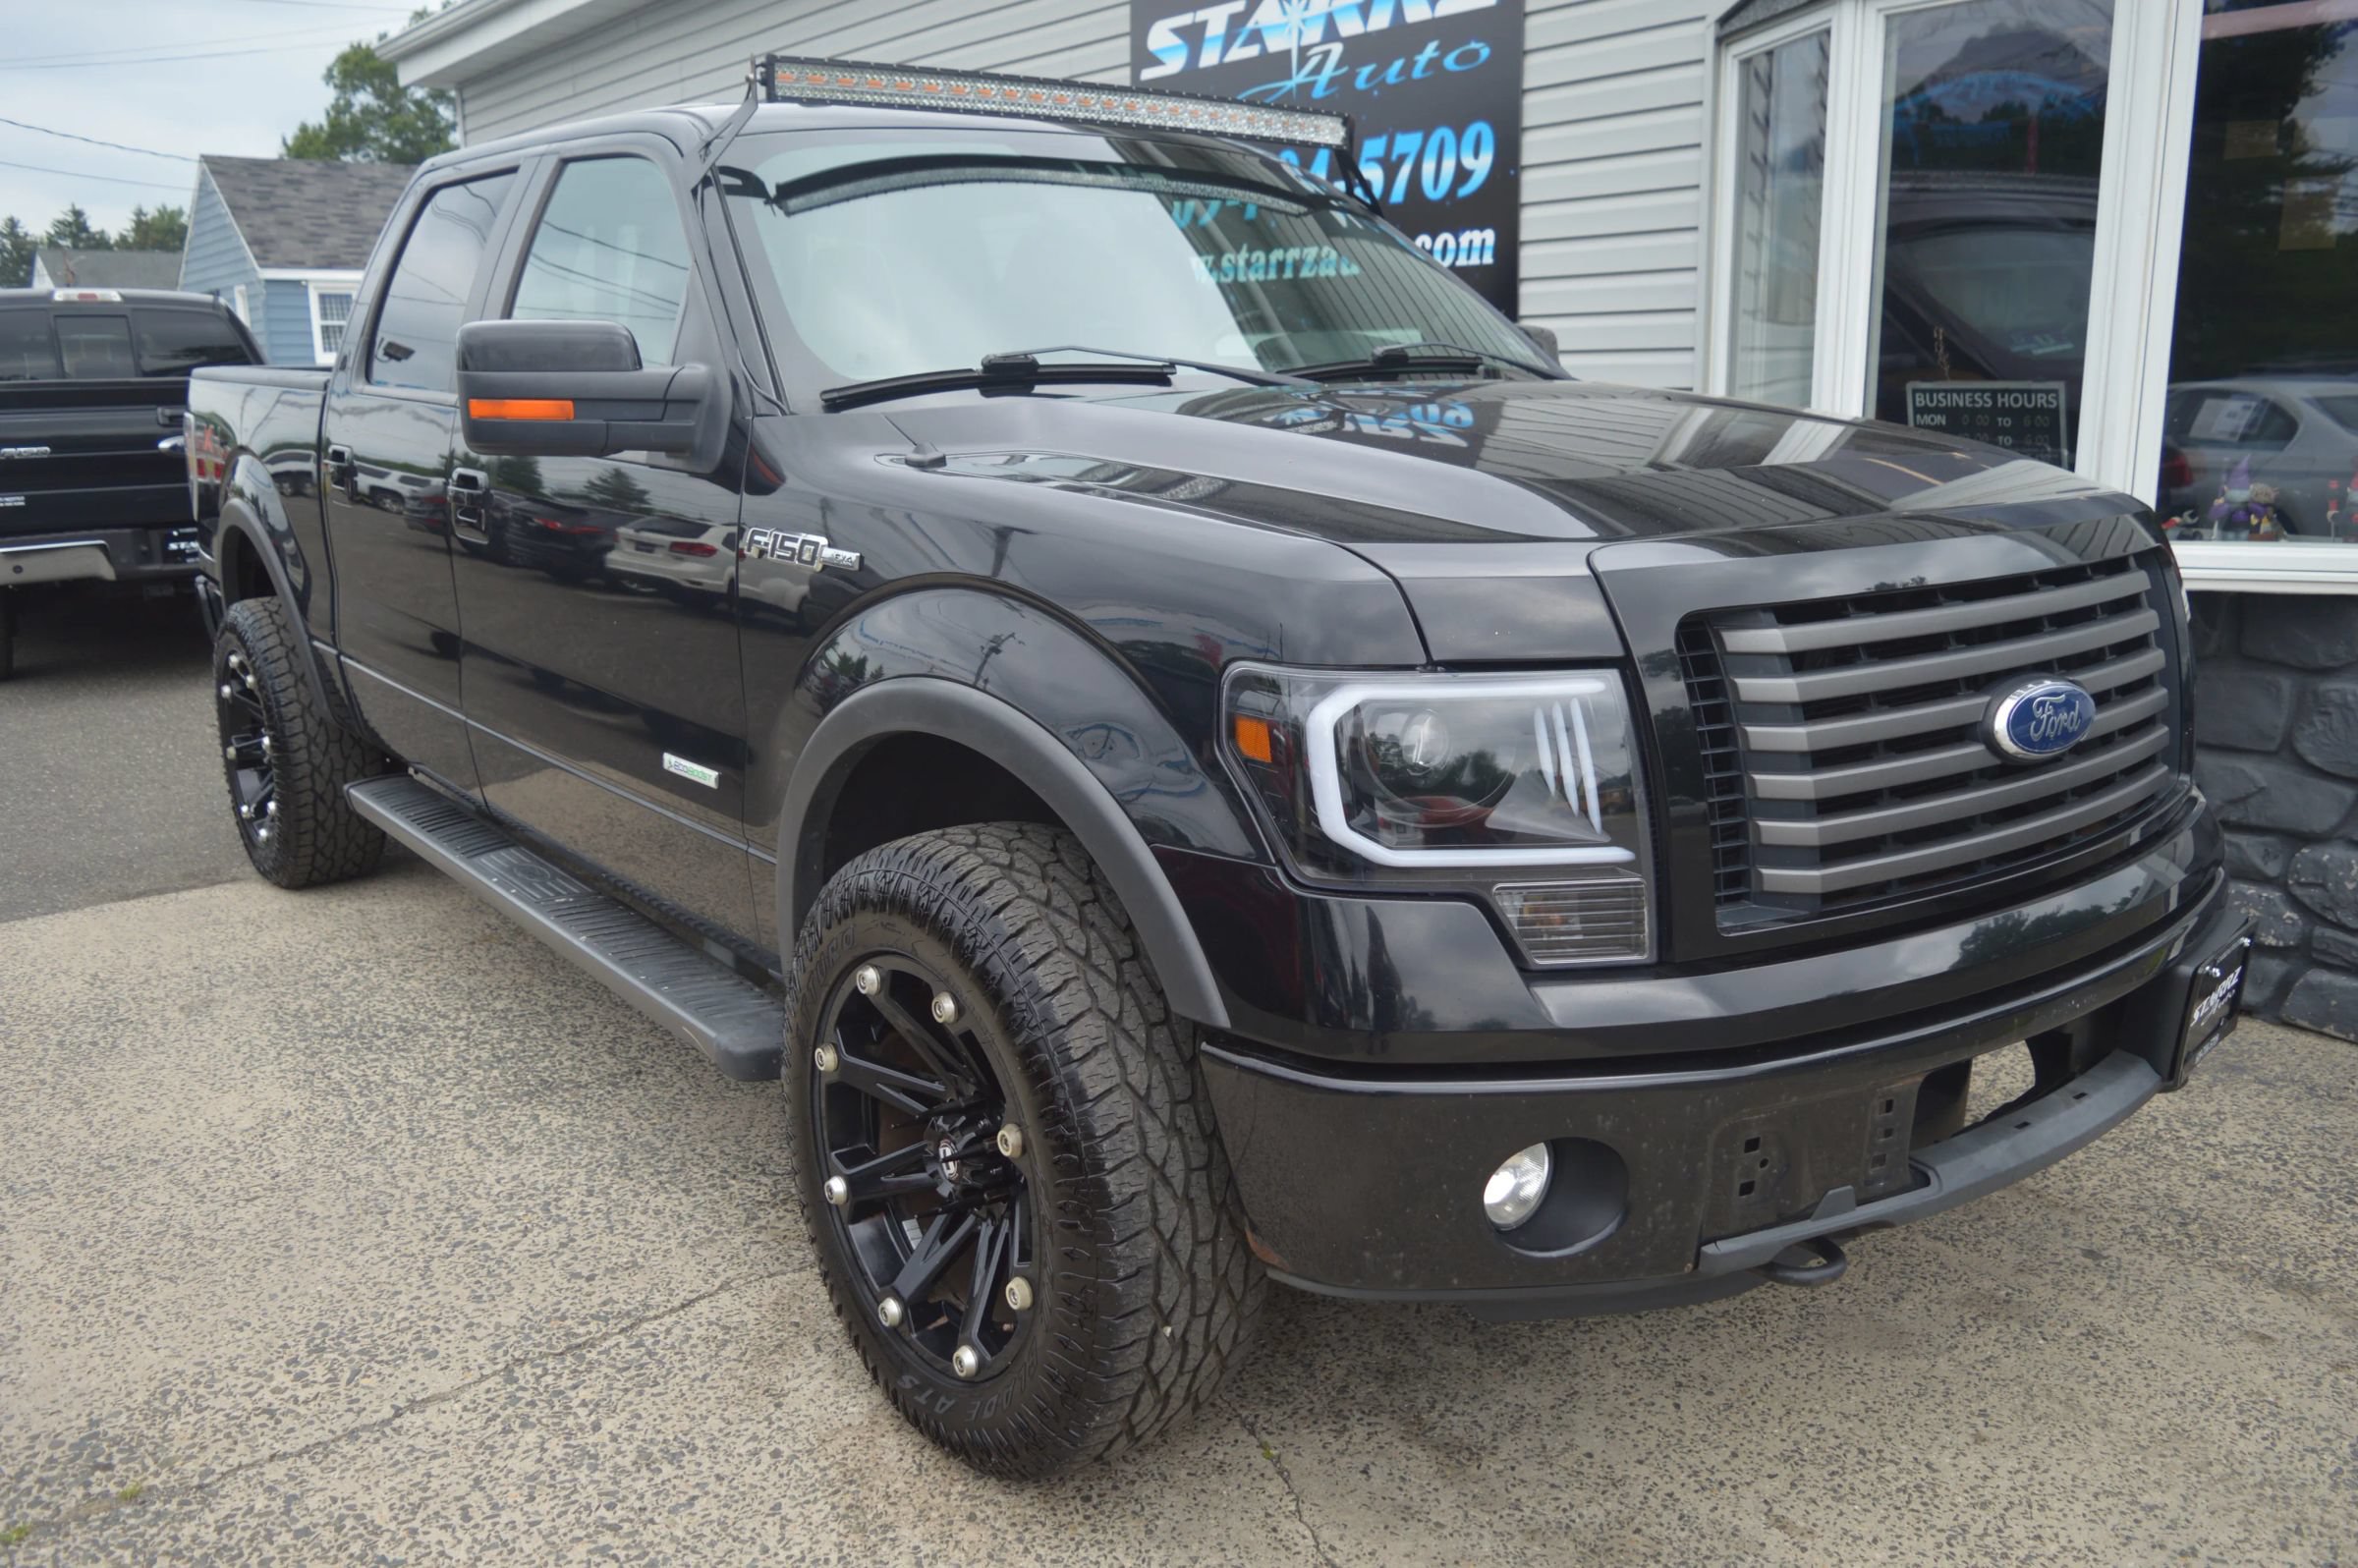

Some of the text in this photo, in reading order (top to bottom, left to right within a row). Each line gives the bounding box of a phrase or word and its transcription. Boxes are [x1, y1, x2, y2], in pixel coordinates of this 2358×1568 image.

[1140, 0, 1499, 81] STAR
[1236, 38, 1491, 102] Auto
[1915, 392, 2058, 409] BUSINESS HOURS
[1916, 413, 1946, 426] MON
[1996, 417, 2012, 427] TO
[1997, 435, 2013, 446] TO
[745, 528, 827, 571] F-150
[2029, 694, 2081, 742] Ford
[896, 1374, 956, 1415] ATS
